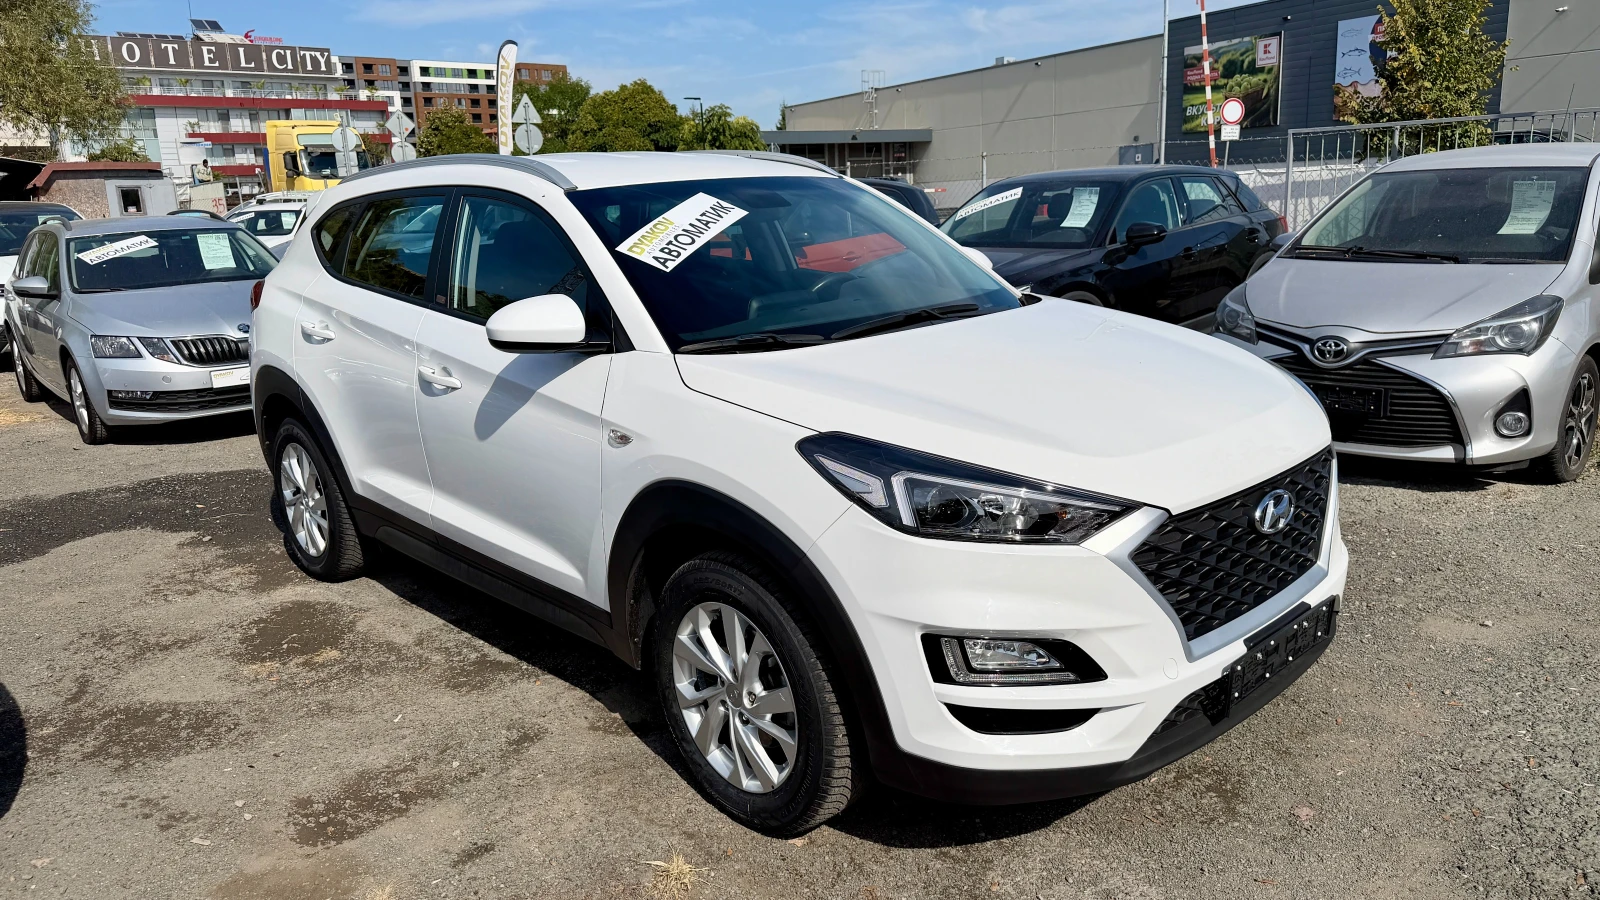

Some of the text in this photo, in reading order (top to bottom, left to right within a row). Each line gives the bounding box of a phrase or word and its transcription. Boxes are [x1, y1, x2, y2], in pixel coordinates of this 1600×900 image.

[271, 49, 329, 71] CITY
[499, 54, 511, 147] DYAKOV
[212, 198, 225, 214] 35
[958, 192, 1020, 219] АВТОМАТИК
[627, 216, 675, 256] DYAKOV
[646, 224, 681, 255] AUTOMOBILES
[652, 201, 736, 270] АВТОМАТИК
[89, 238, 151, 264] АВТОМАТИК
